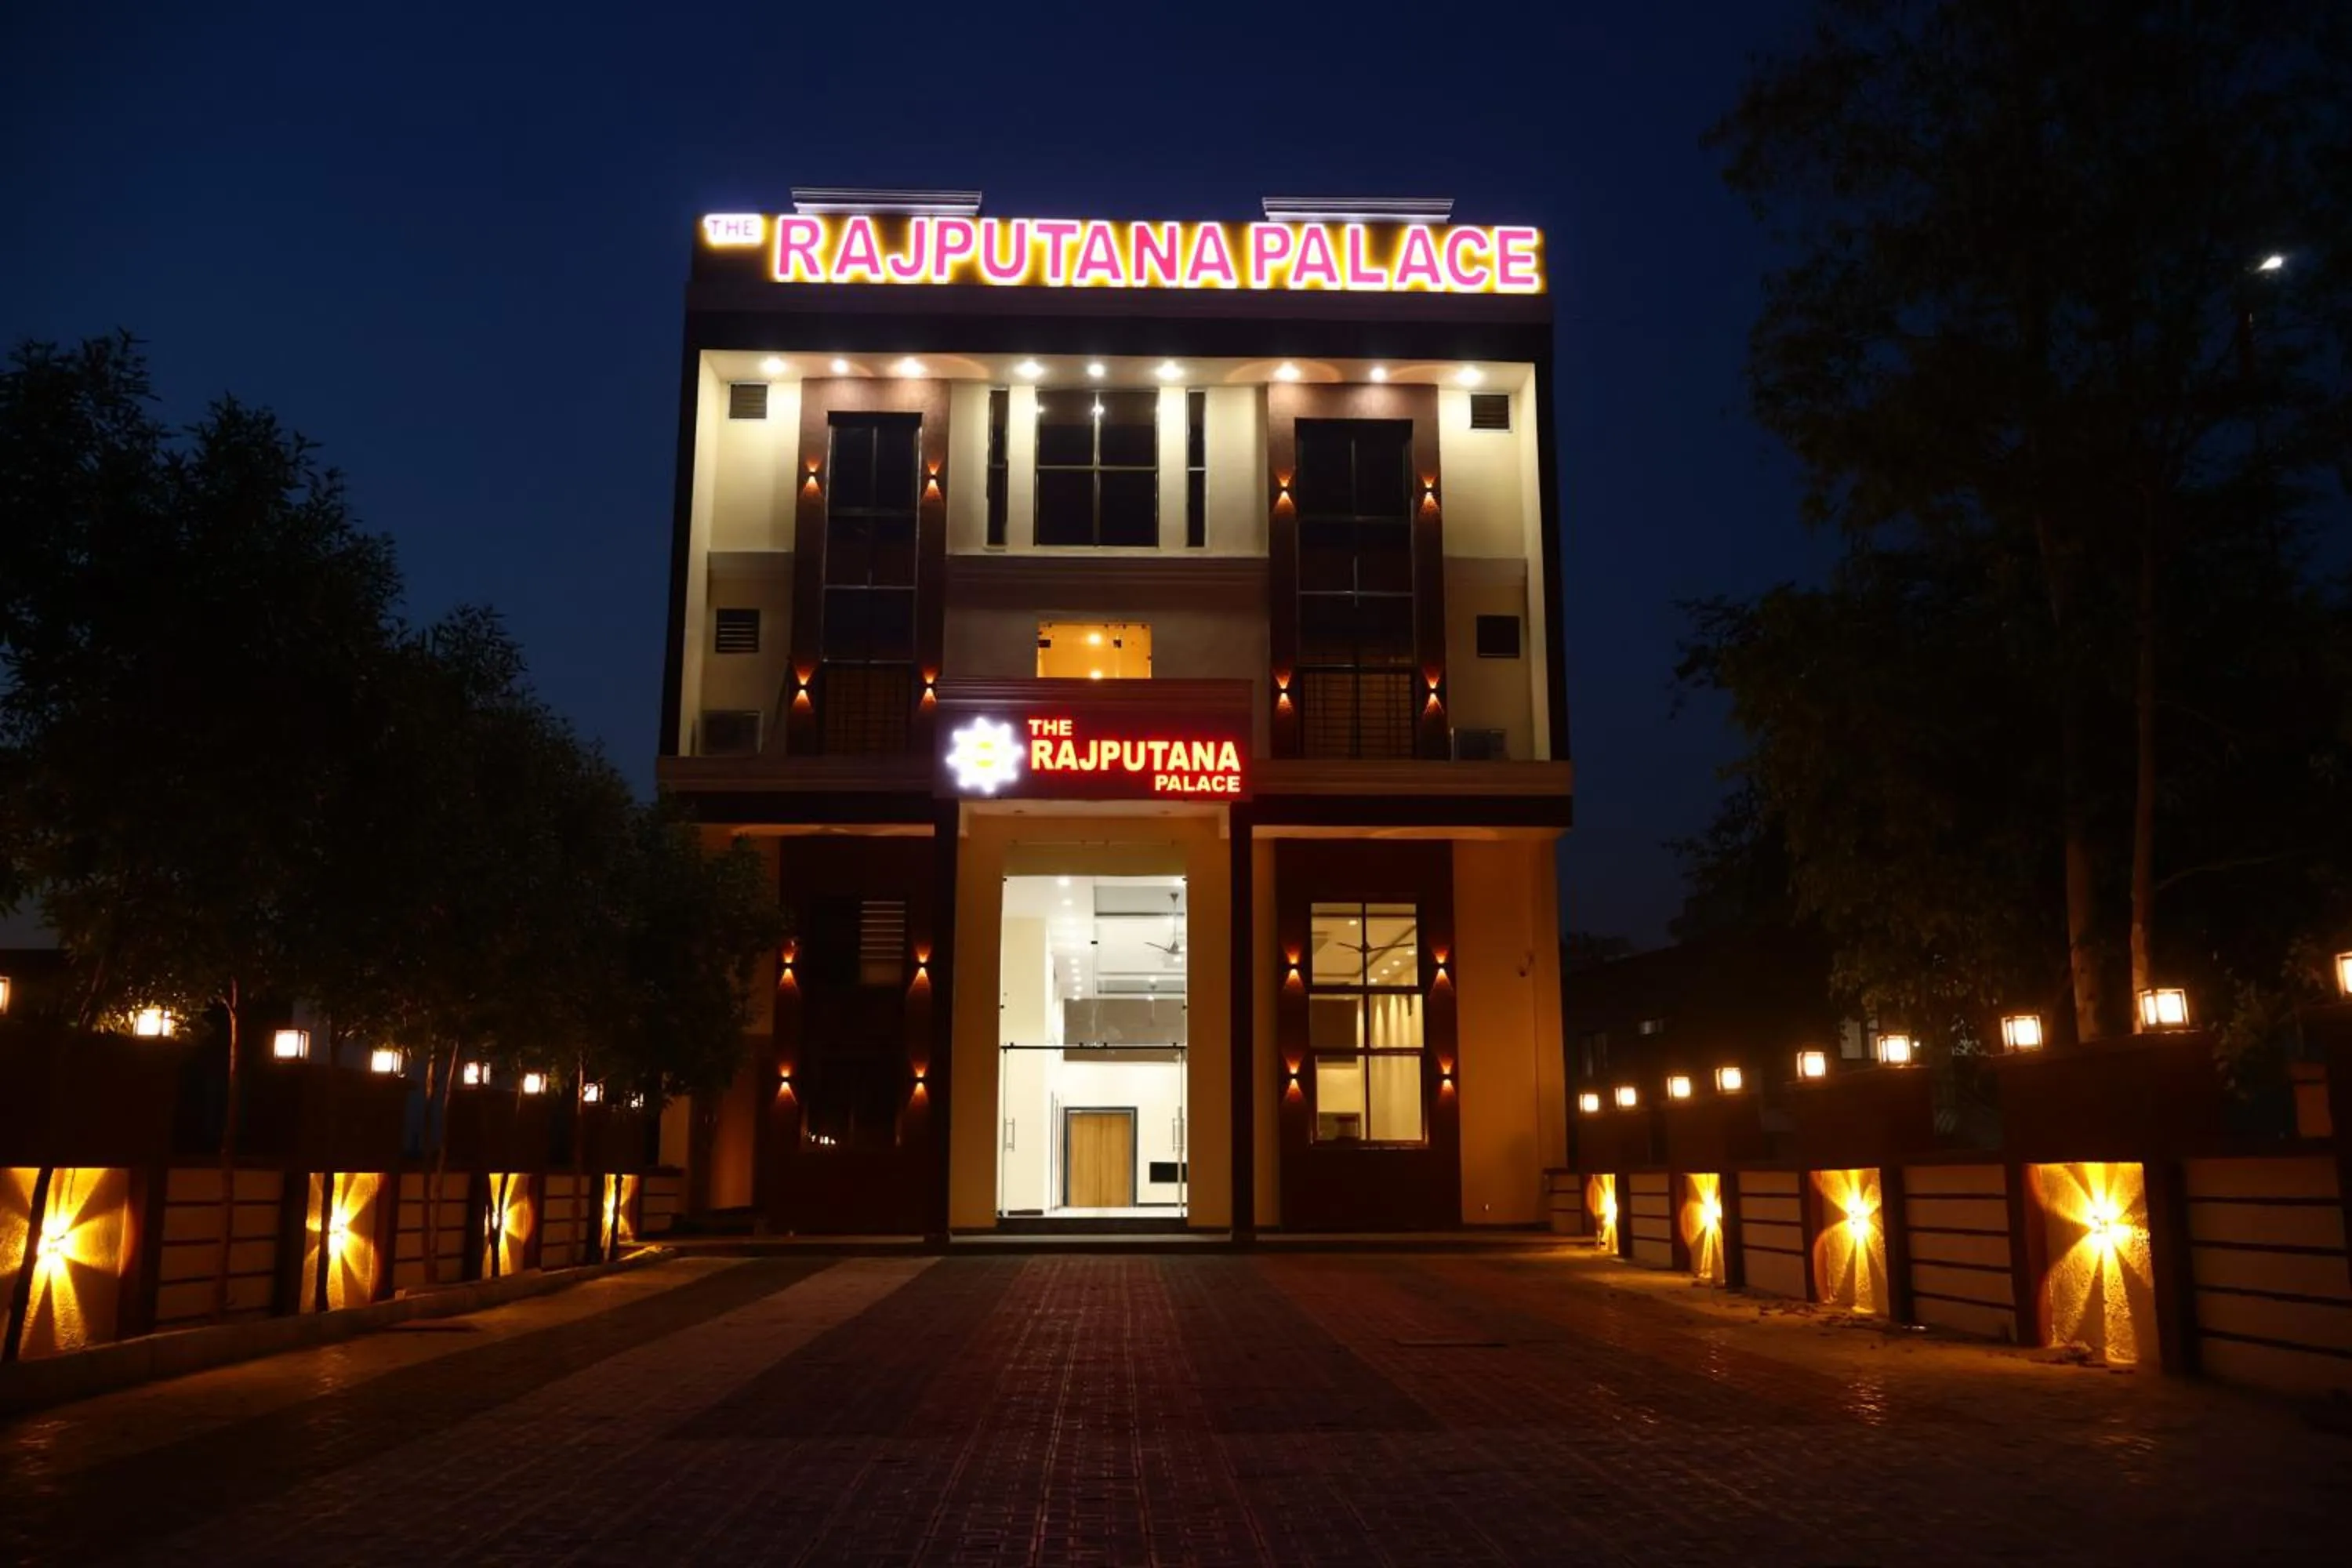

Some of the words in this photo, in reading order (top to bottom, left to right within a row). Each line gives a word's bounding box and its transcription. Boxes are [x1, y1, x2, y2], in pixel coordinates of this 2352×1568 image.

[709, 218, 756, 238] THE
[778, 218, 1234, 281] RAJPUTANA
[1254, 227, 1536, 285] PALACE
[1029, 719, 1073, 736] THE
[1031, 740, 1241, 771] RAJPUTANA
[1154, 775, 1241, 792] PALACE
